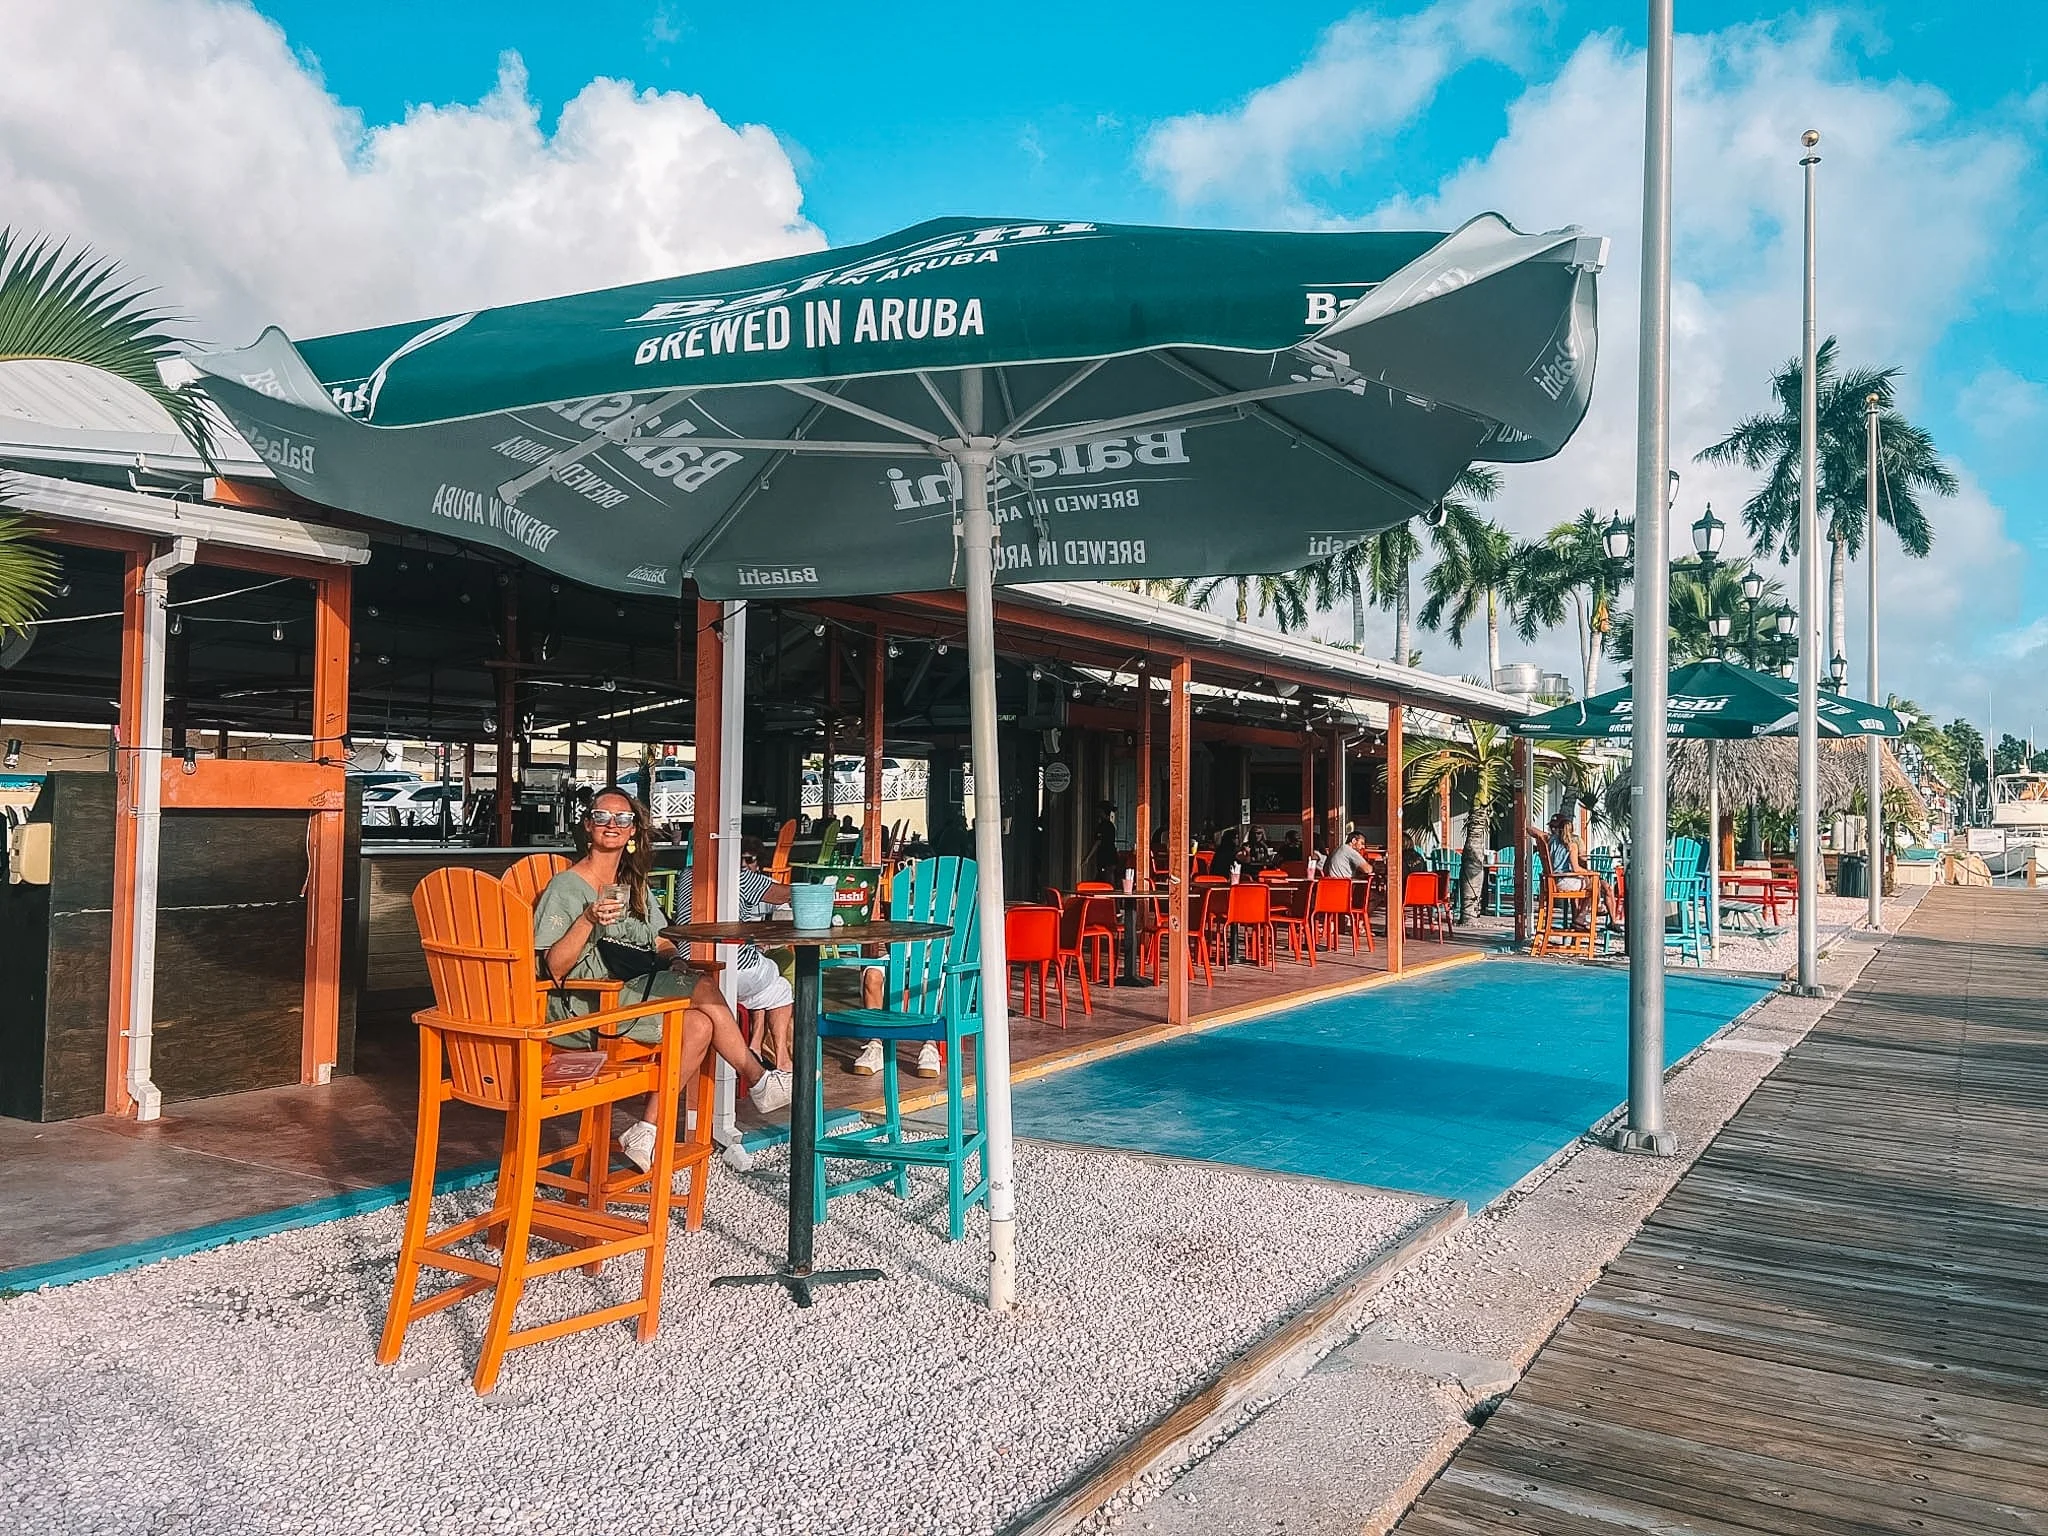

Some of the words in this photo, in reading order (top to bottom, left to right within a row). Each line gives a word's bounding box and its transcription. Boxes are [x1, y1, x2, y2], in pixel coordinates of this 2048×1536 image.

[876, 249, 999, 283] ARUBA
[634, 305, 791, 366] BREWED
[805, 299, 841, 349] IN
[853, 298, 985, 343] ARUBA
[834, 891, 865, 901] lashi
